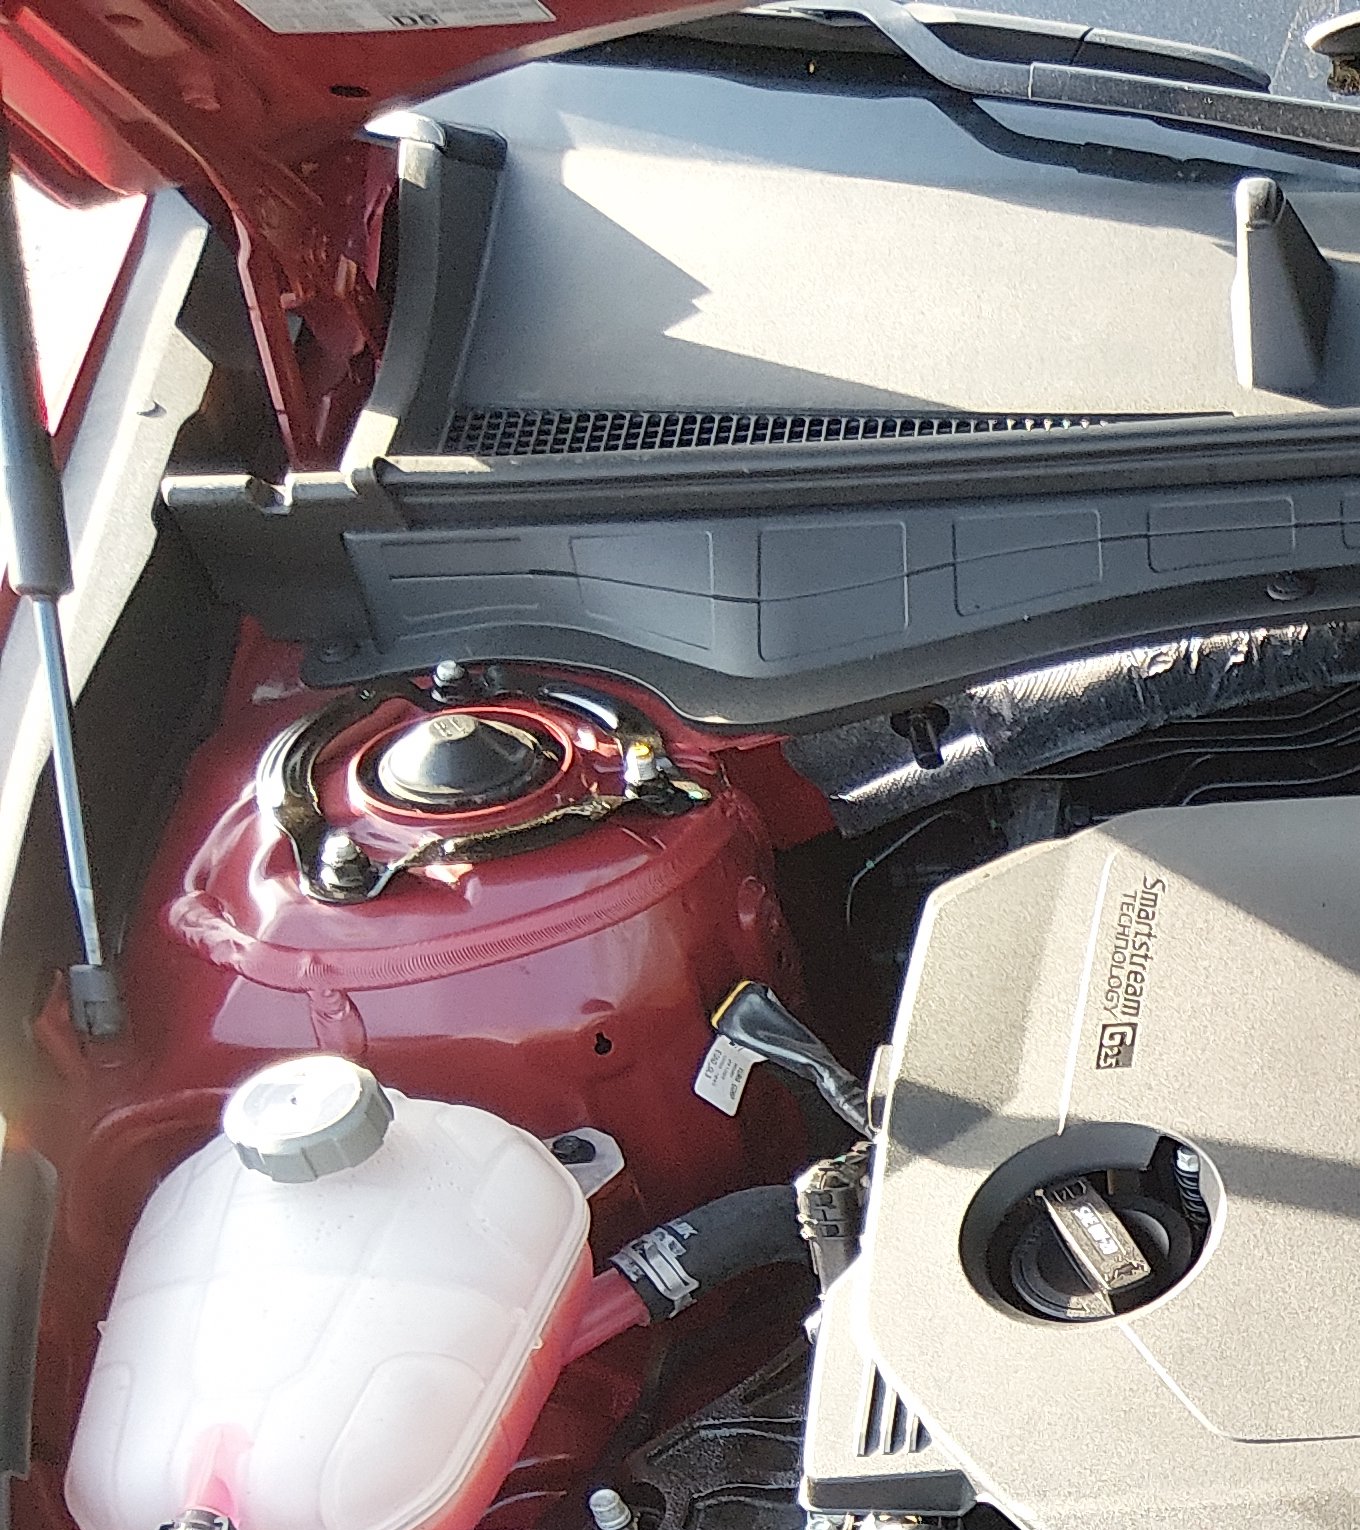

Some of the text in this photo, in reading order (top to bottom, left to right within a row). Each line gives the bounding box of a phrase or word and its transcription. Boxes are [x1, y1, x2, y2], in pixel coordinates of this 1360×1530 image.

[1098, 890, 1138, 1069] TECHNOLOGY G25
[1121, 875, 1167, 1018] Smartstream
